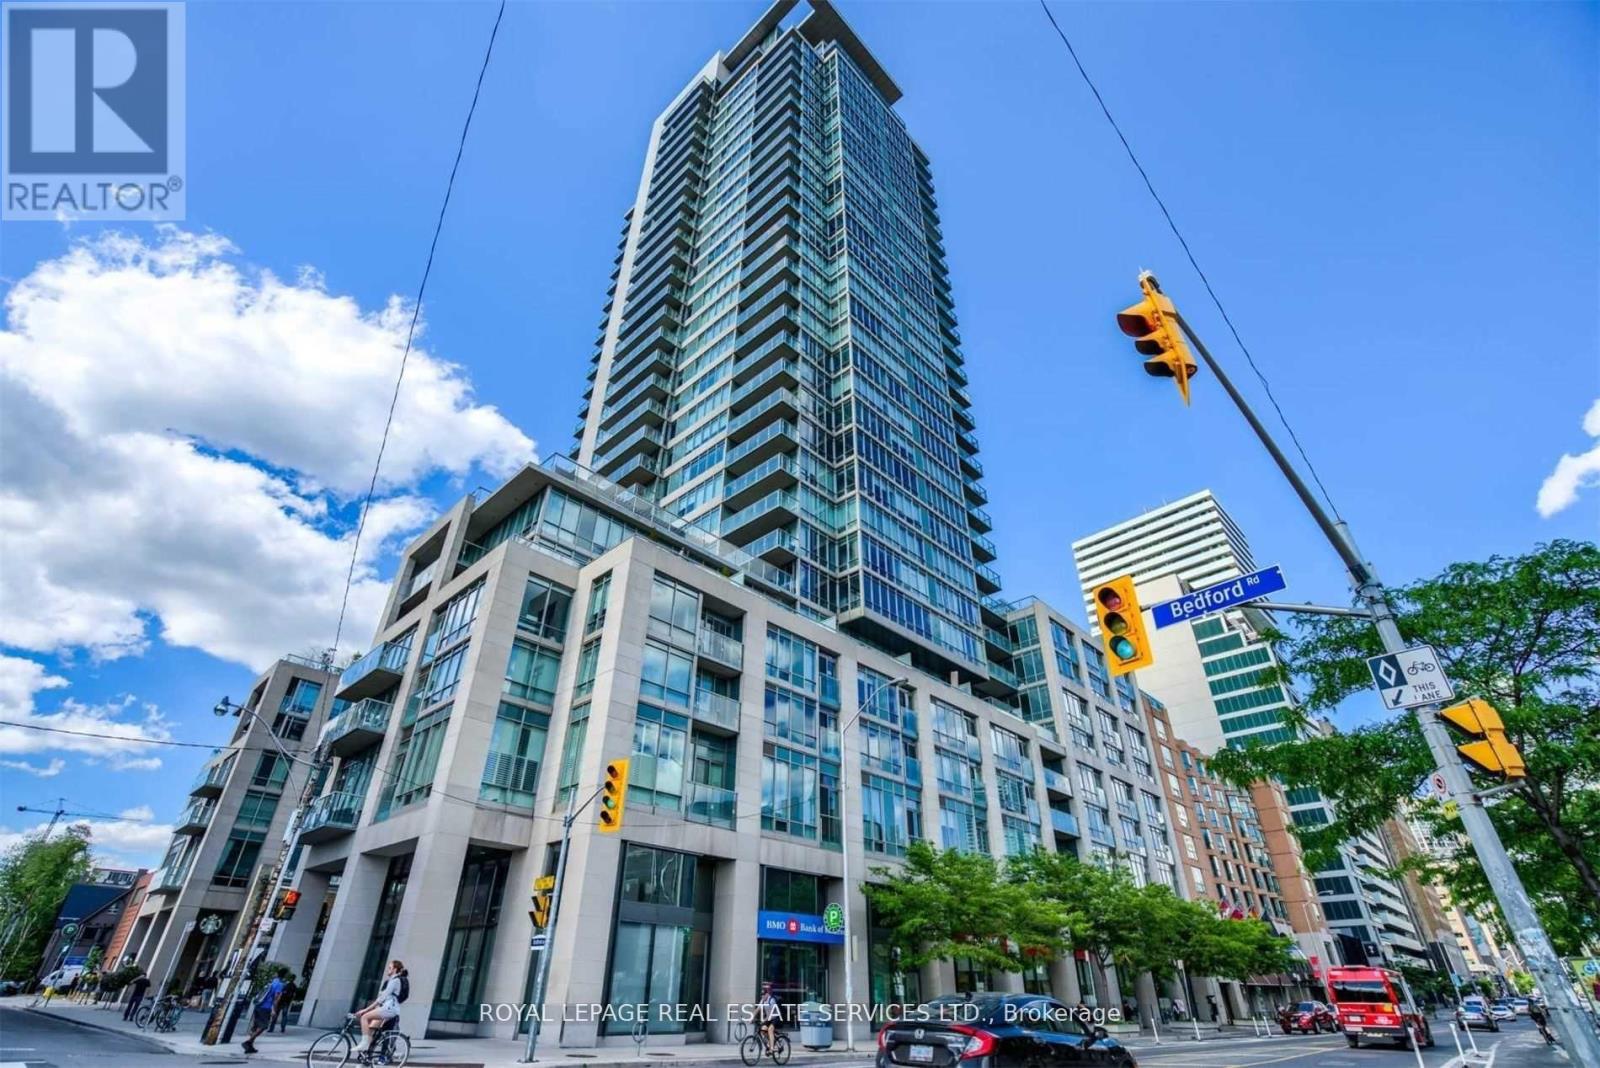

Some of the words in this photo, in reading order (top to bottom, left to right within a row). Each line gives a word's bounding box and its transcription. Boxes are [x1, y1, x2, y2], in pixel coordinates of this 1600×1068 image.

[1170, 581, 1244, 618] Bedford
[1246, 575, 1260, 586] Rd
[1412, 681, 1436, 693] THIS
[766, 920, 786, 930] BMO
[800, 922, 817, 933] Bank
